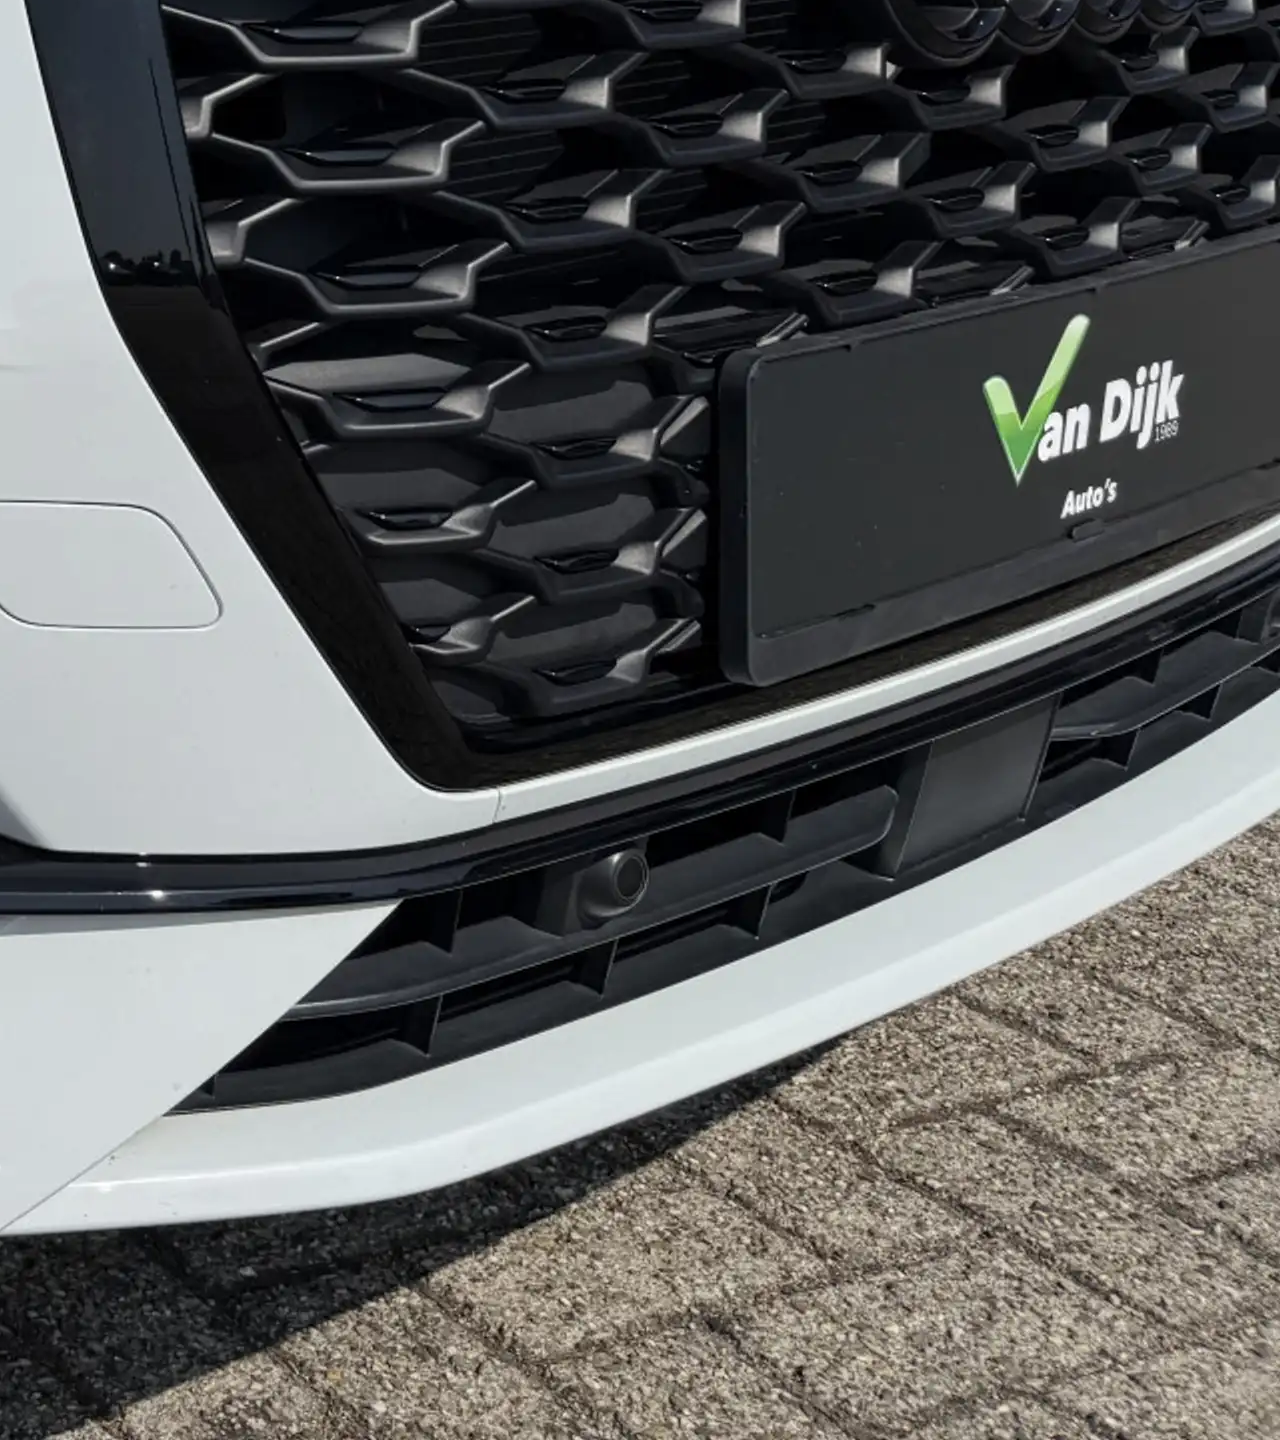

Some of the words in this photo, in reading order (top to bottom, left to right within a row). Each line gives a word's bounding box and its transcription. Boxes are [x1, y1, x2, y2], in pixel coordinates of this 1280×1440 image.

[983, 314, 1091, 488] Van
[1099, 360, 1185, 449] Dijk
[1060, 478, 1118, 519] Auto's
